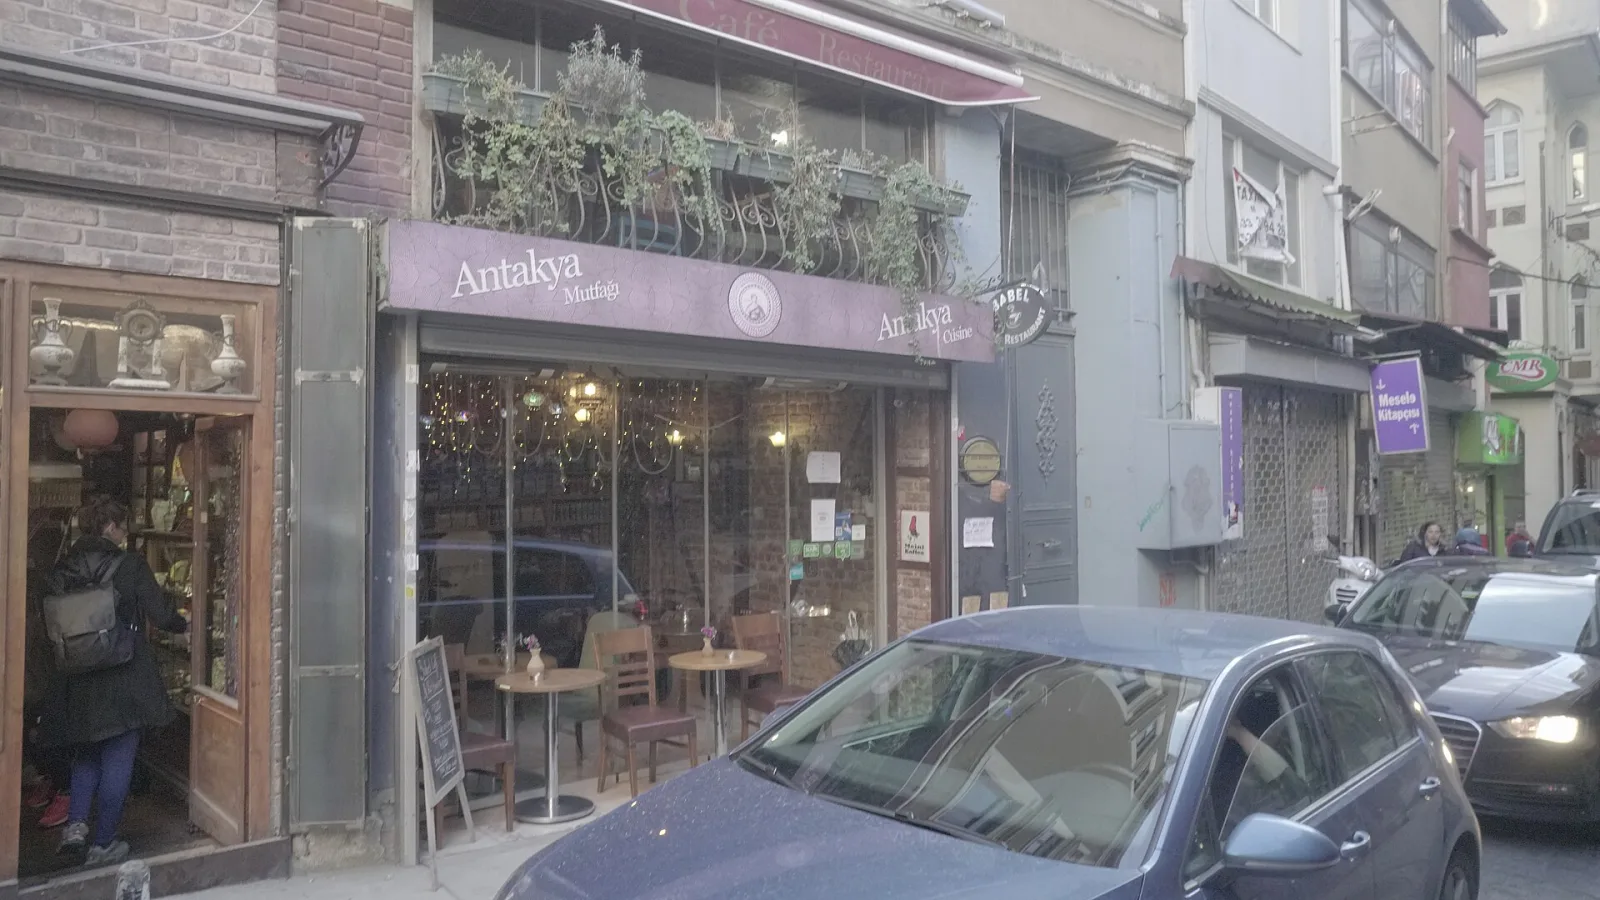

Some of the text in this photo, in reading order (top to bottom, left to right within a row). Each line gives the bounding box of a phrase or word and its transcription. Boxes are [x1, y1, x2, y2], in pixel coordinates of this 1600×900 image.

[451, 248, 583, 298] Antakya
[563, 279, 621, 305] Mutfağı
[992, 287, 1030, 313] BABEL
[877, 302, 952, 341] Anakya
[1004, 305, 1046, 345] RESTAURANT
[1500, 359, 1544, 378] CMR
[1378, 408, 1420, 422] Kitapçısı
